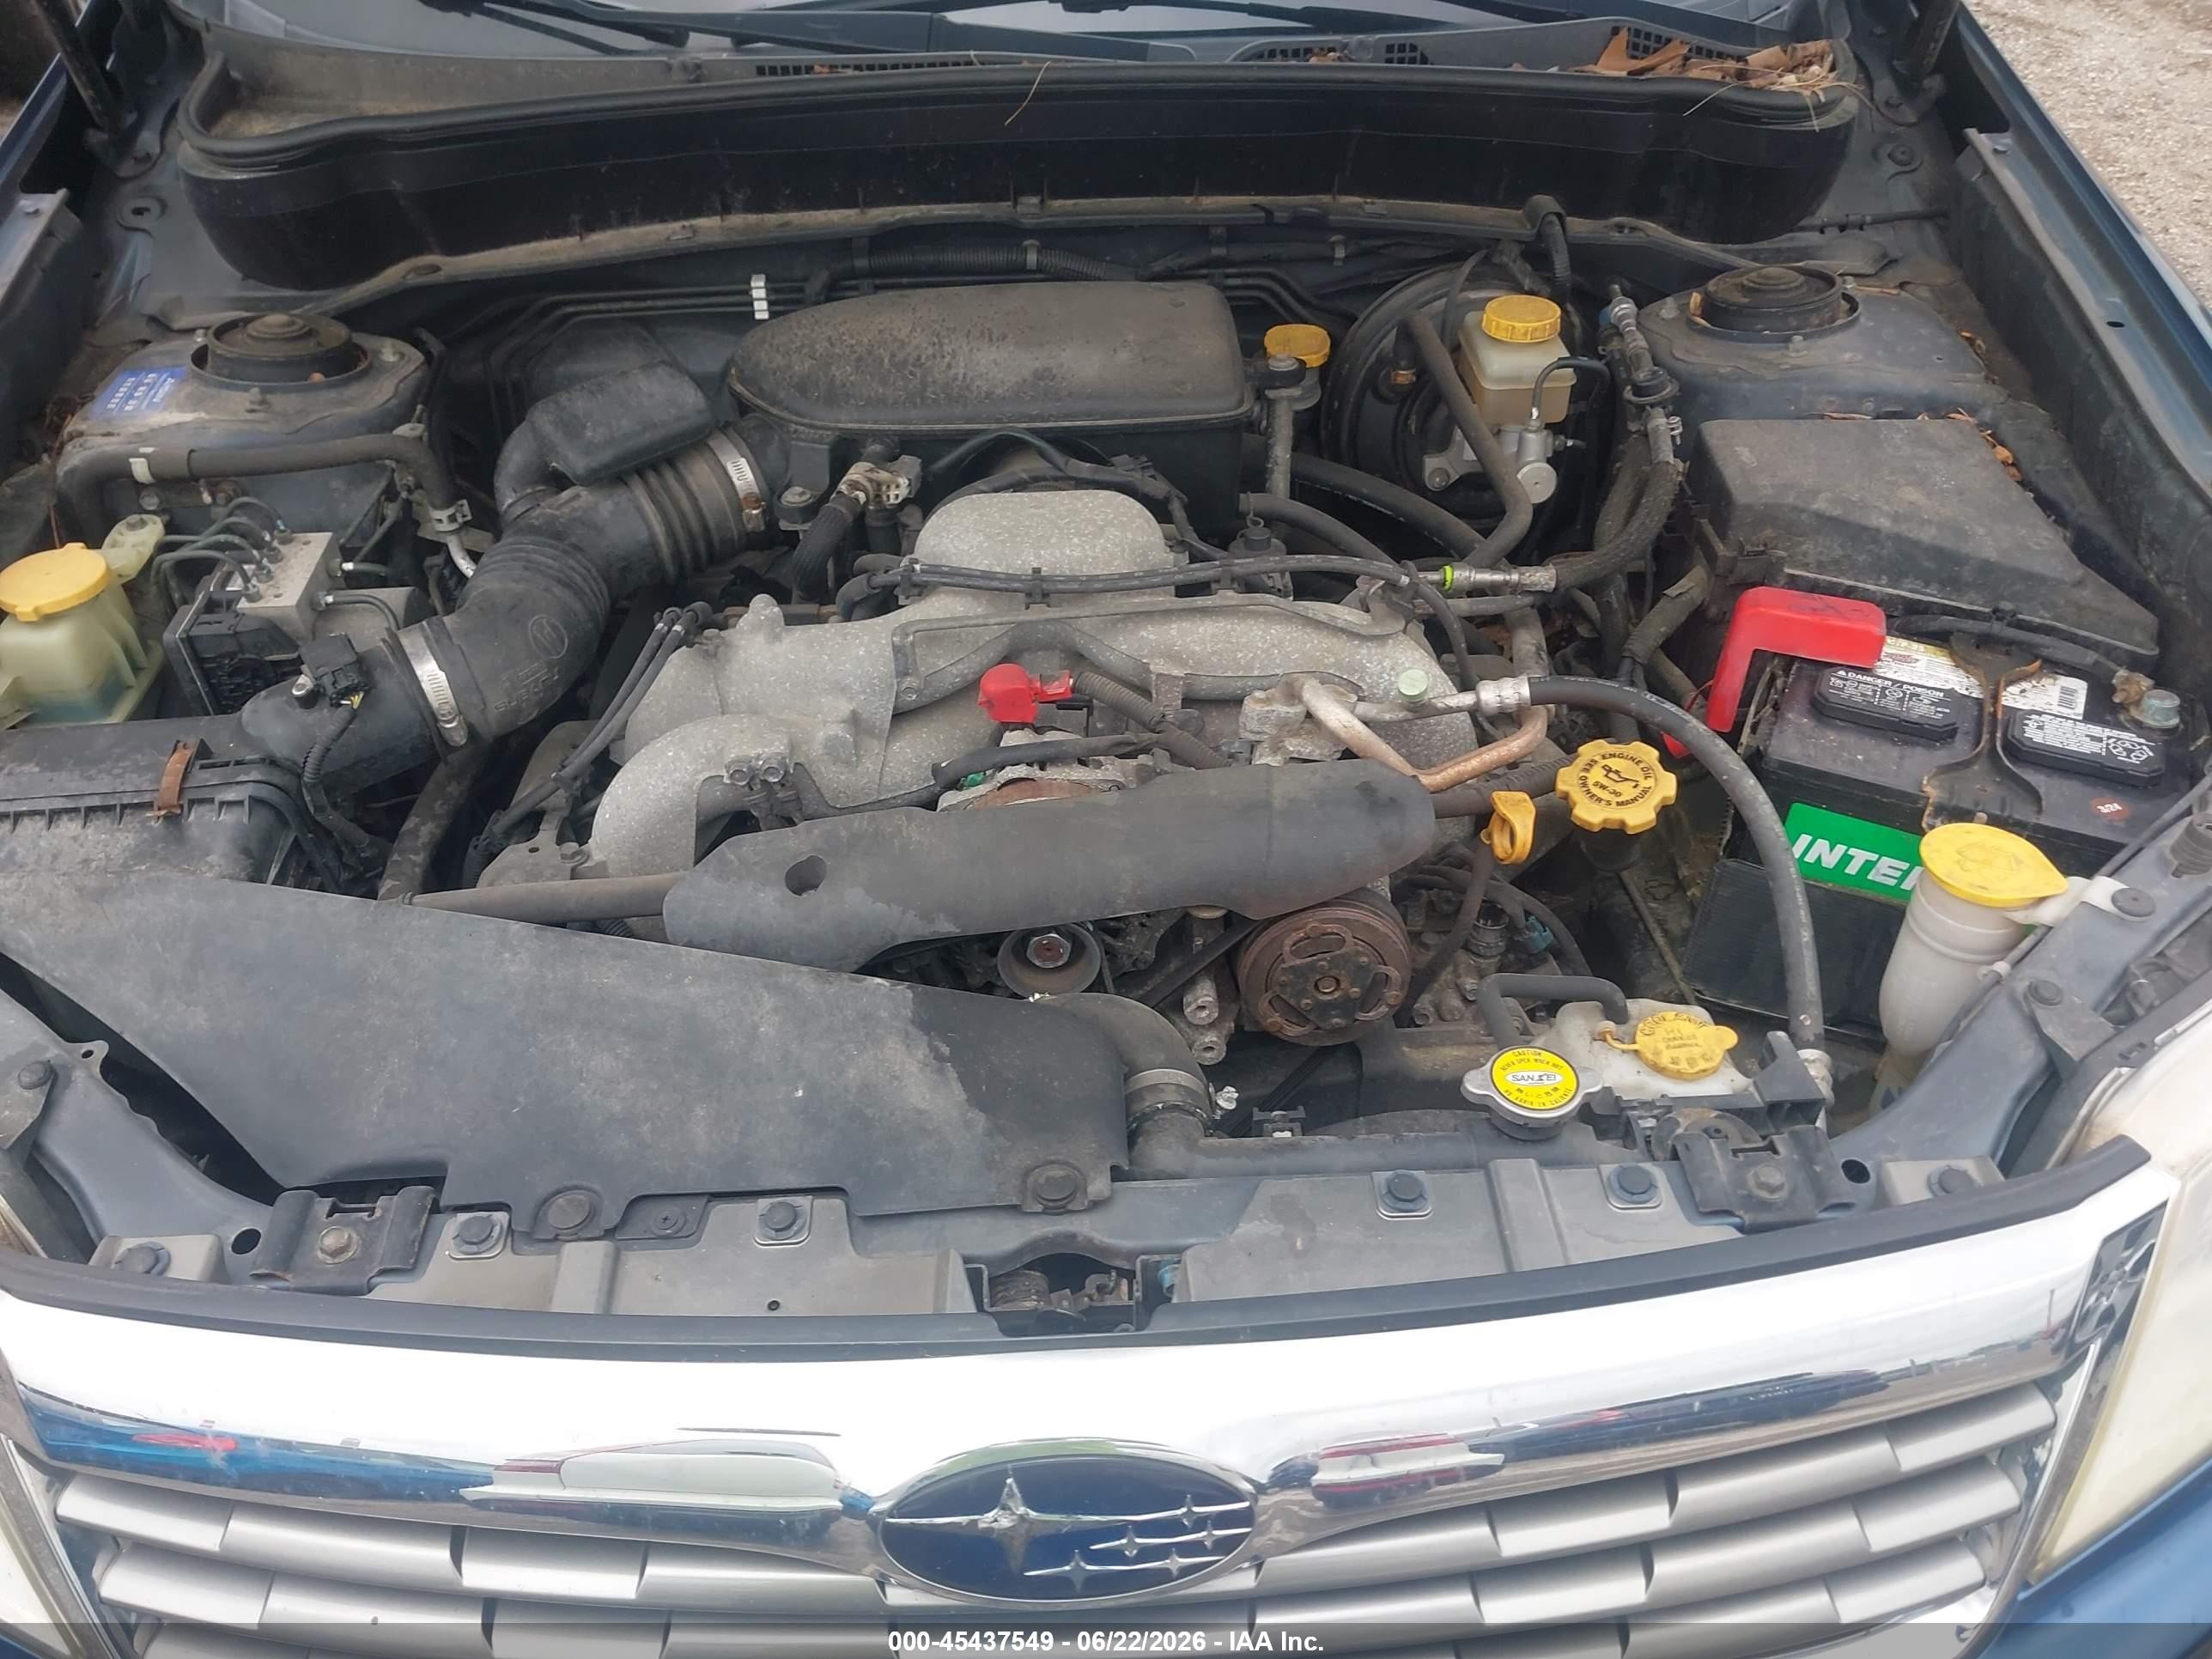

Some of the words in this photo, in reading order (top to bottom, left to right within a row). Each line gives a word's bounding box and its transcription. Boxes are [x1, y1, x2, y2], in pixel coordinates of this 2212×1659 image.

[1847, 672, 1893, 687] DANGER
[1902, 684, 1945, 697] POISON
[1582, 758, 1599, 773] SEE
[1601, 752, 1644, 766] ENGINE
[1640, 765, 1653, 781] OIL
[1579, 775, 1612, 806] OWNER'S
[1592, 781, 1622, 798] 5W-30
[1615, 786, 1652, 807] MANUAL
